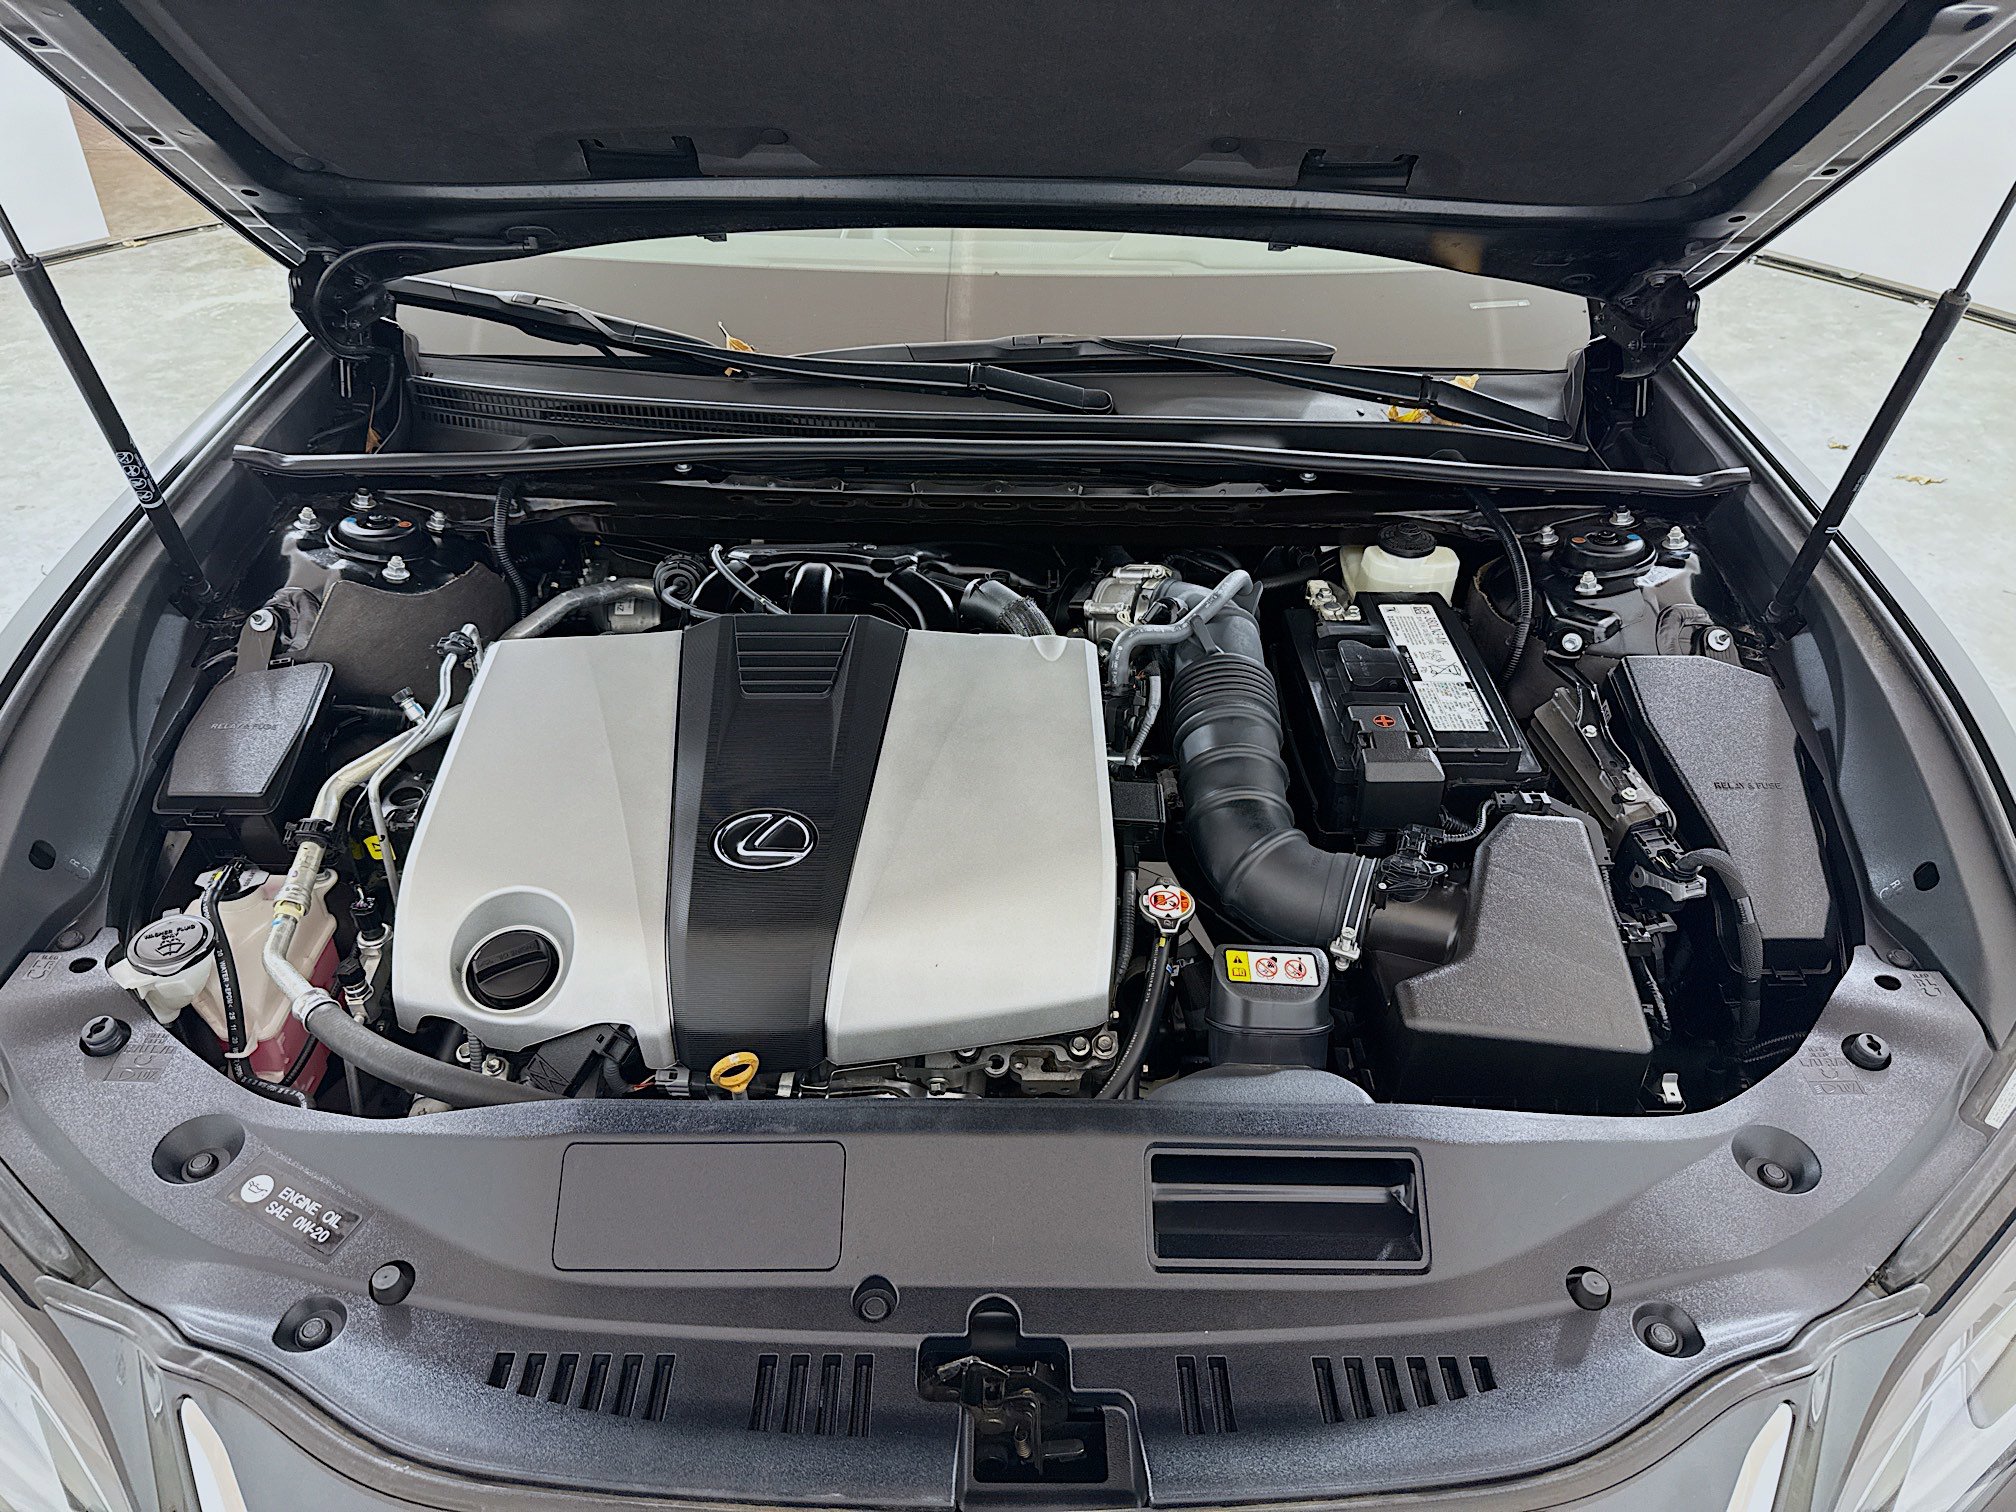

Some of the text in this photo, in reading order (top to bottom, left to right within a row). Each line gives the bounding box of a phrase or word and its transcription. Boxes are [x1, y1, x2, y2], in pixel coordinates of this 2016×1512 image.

[1713, 781, 1745, 790] RELAY
[1756, 782, 1782, 790] FUSE
[219, 960, 230, 983] WATER
[264, 1200, 331, 1243] SAE 0W-20
[278, 1186, 342, 1229] ENGINE OIL
